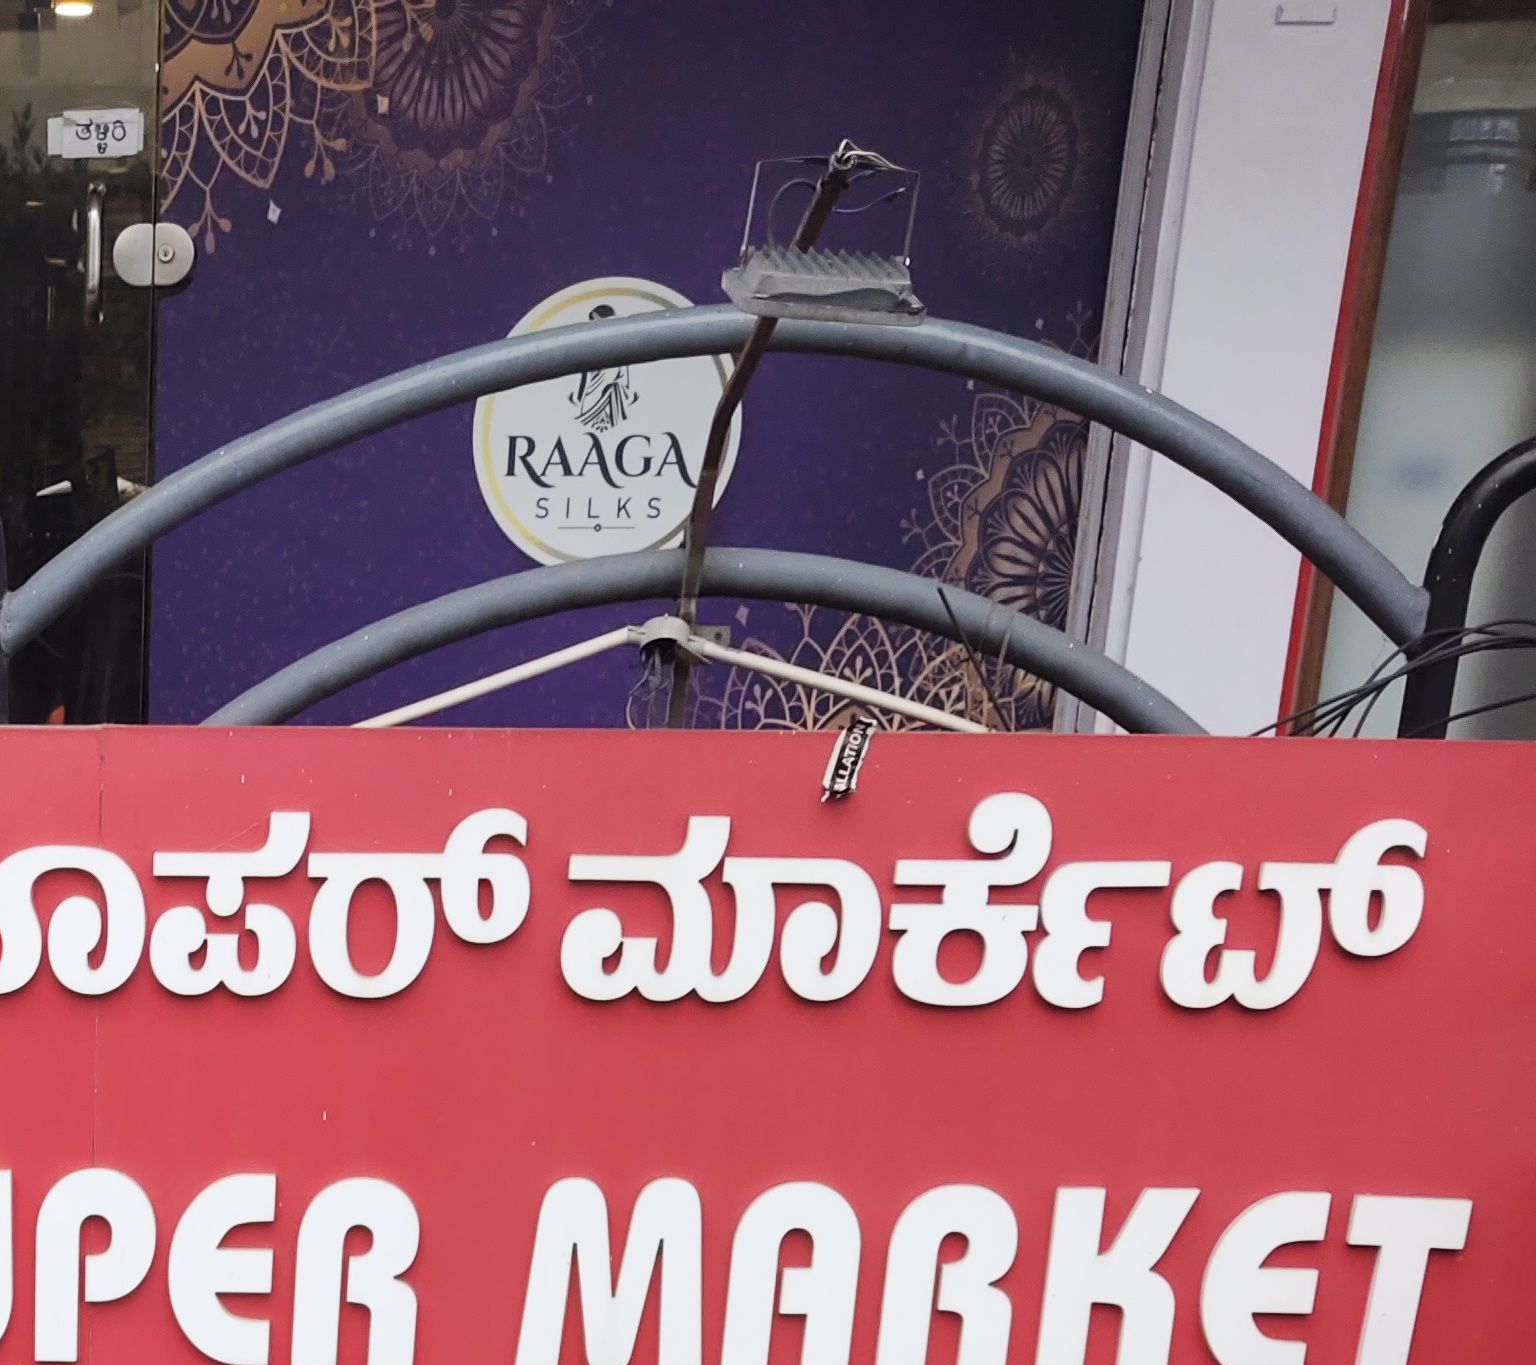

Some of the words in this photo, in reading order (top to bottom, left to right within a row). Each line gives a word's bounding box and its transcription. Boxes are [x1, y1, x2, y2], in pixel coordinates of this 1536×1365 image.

[504, 432, 698, 488] RAAGA
[535, 497, 661, 519] SILKS
[559, 791, 1428, 1011] ಮಾರ್ಕೆಟ್
